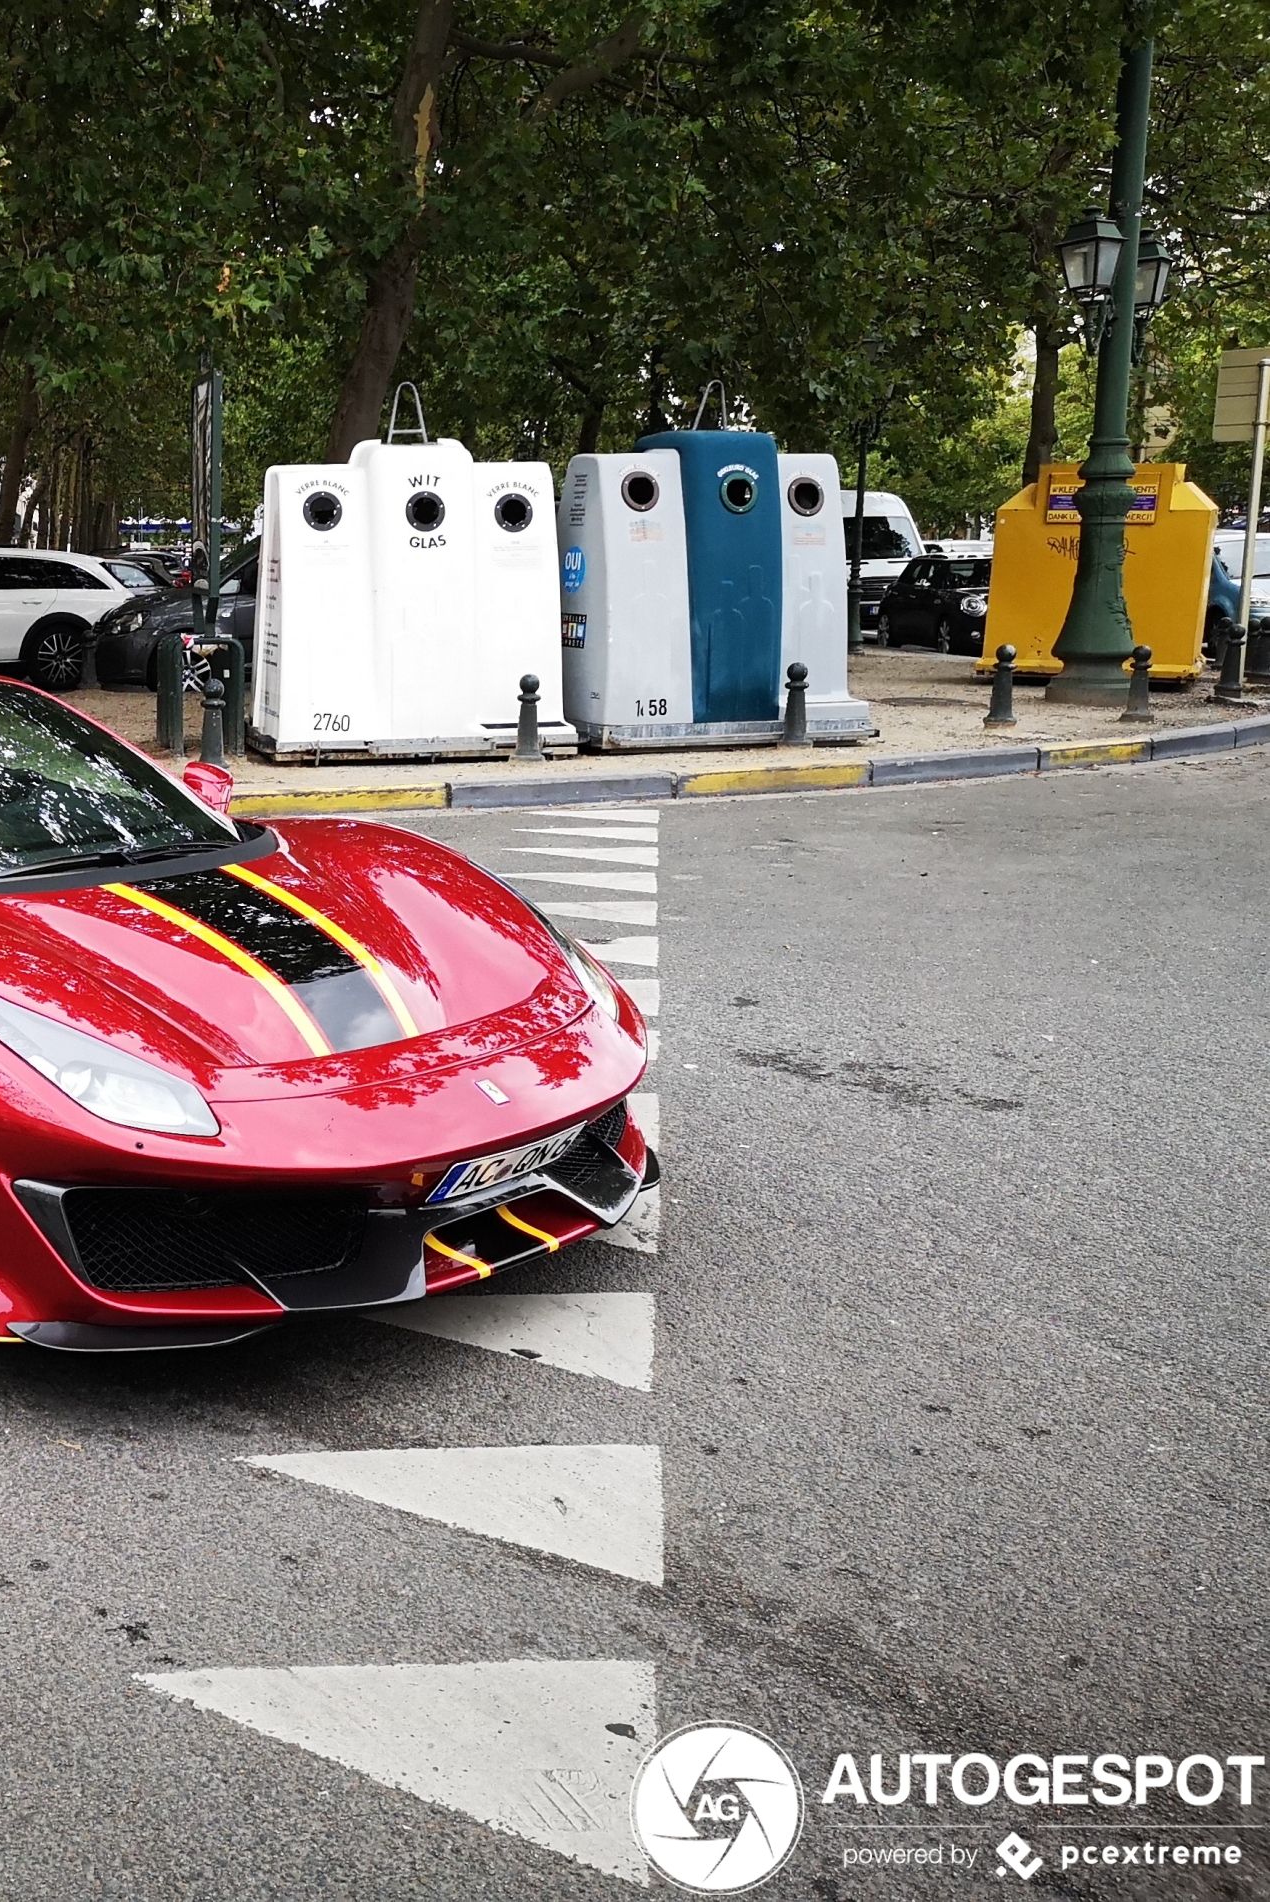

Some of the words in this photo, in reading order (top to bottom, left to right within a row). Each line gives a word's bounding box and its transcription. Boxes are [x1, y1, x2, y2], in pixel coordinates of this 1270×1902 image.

[295, 479, 320, 495] VERRE
[322, 479, 350, 497] BLANC
[407, 475, 441, 488] WIT
[486, 481, 510, 498] VERRE
[512, 481, 540, 498] BLANC
[409, 535, 447, 549] GLAS
[565, 552, 581, 571] OUI
[313, 713, 351, 732] 2760
[451, 1158, 505, 1193] AC
